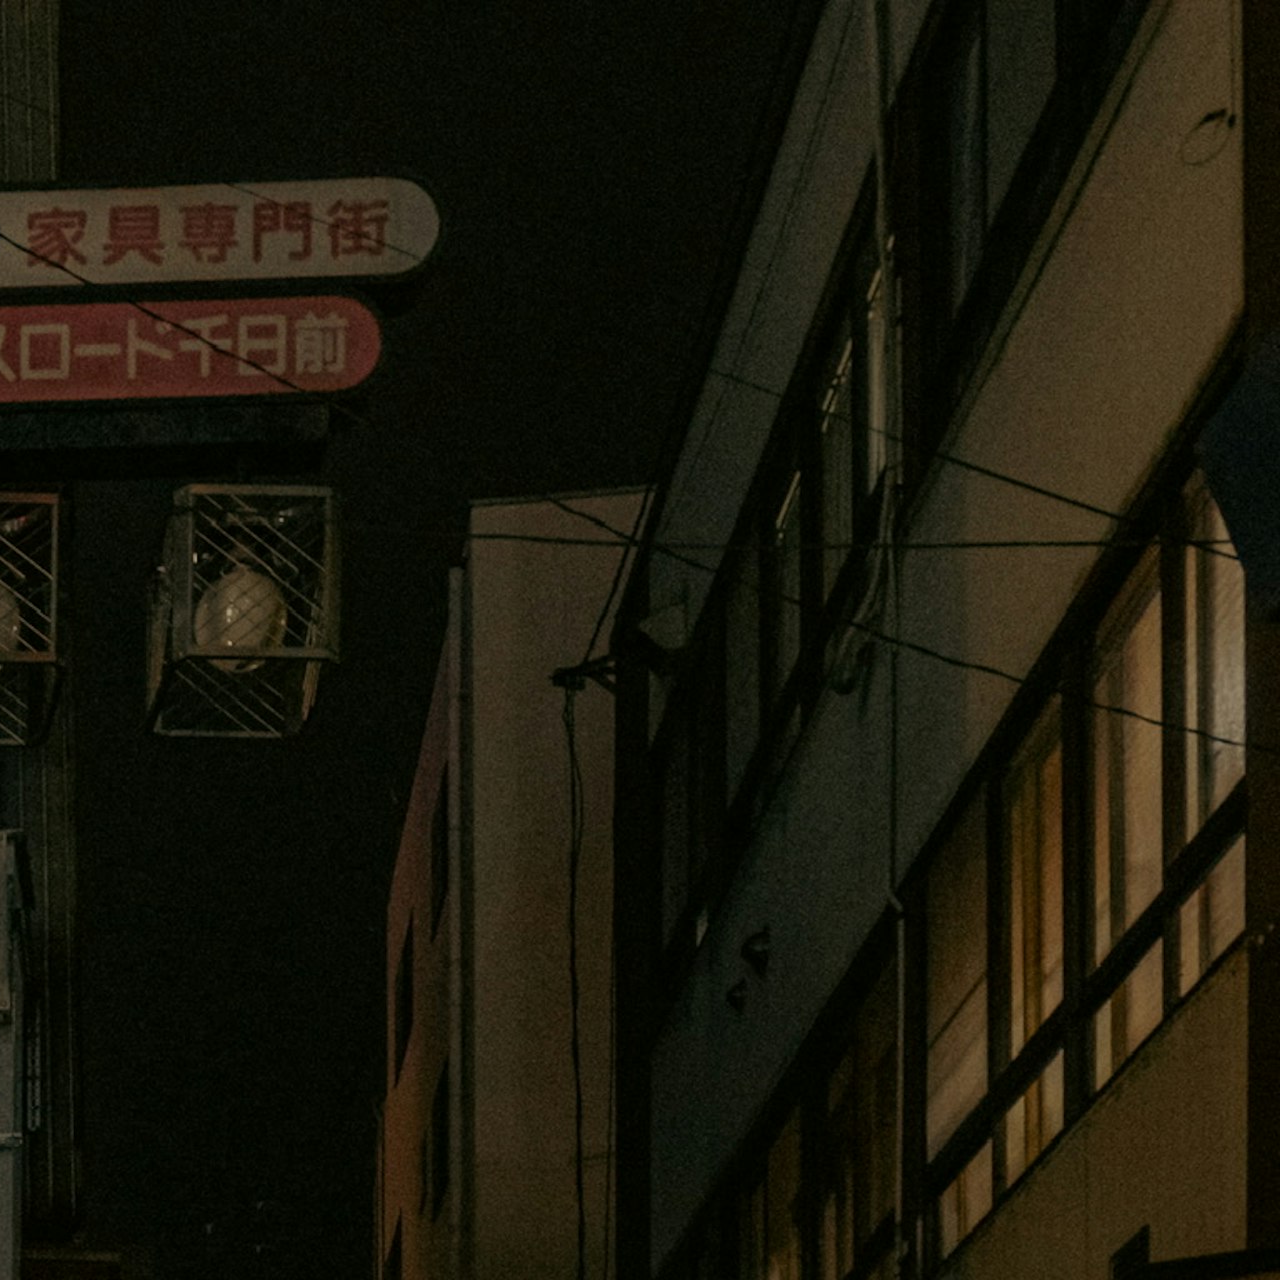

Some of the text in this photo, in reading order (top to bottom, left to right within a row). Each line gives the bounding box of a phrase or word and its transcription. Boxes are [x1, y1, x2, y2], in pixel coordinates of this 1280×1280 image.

[26, 200, 390, 268] 家具専門街
